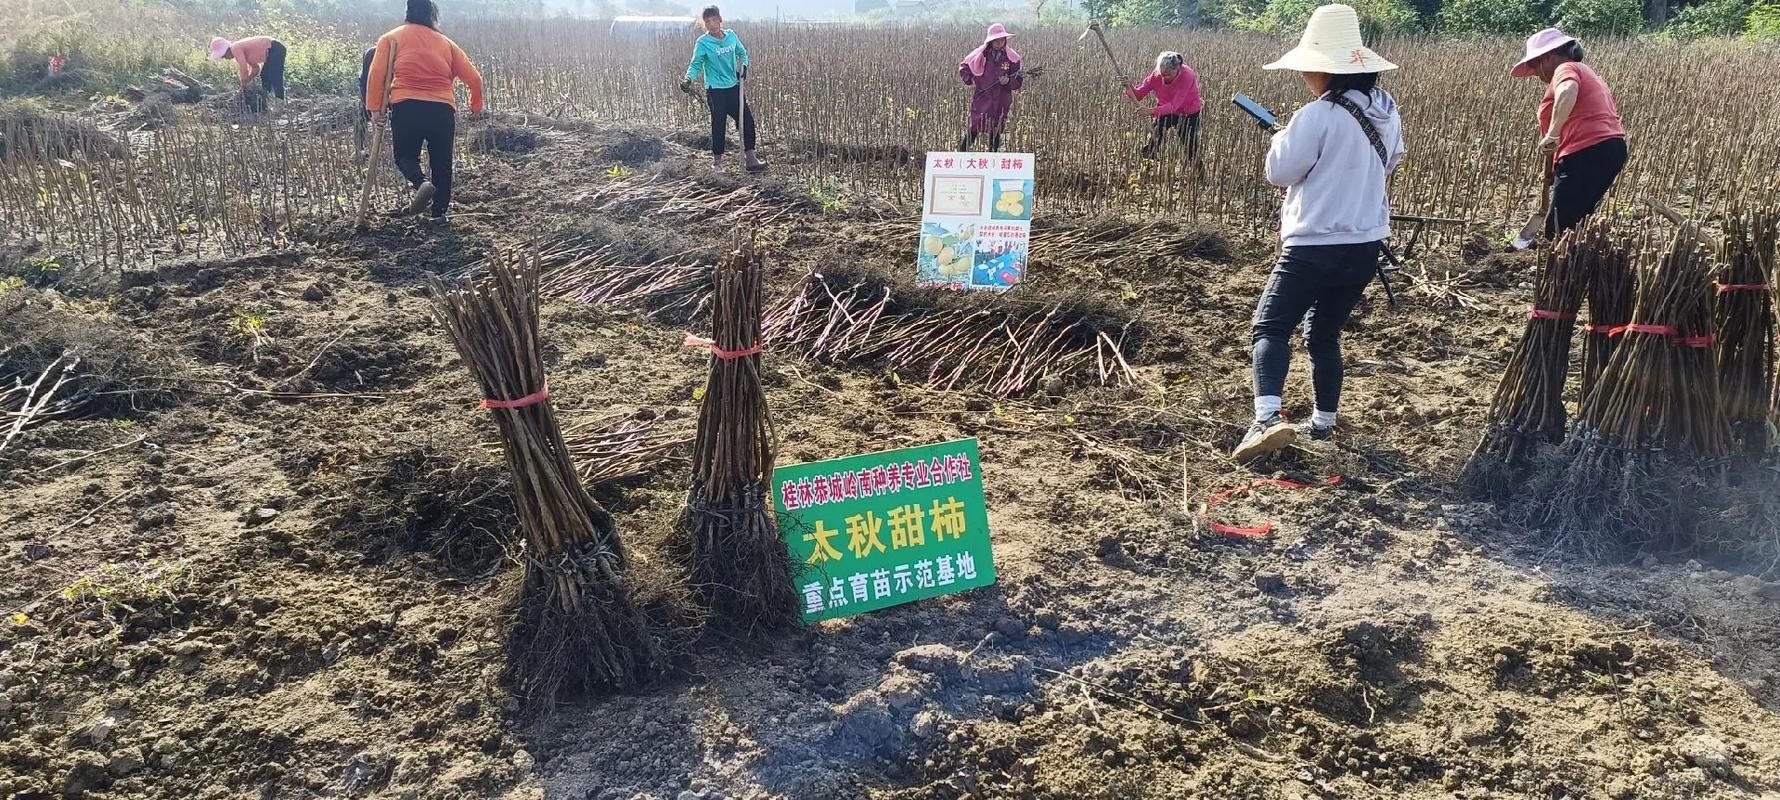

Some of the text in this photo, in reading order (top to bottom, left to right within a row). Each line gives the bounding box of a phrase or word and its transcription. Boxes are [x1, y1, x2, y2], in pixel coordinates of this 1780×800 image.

[781, 453, 972, 511] 桂林恭城岭南种养专业合作社
[802, 496, 966, 565] 太秋甜柿
[802, 551, 977, 614] 重点育苗示范基地
